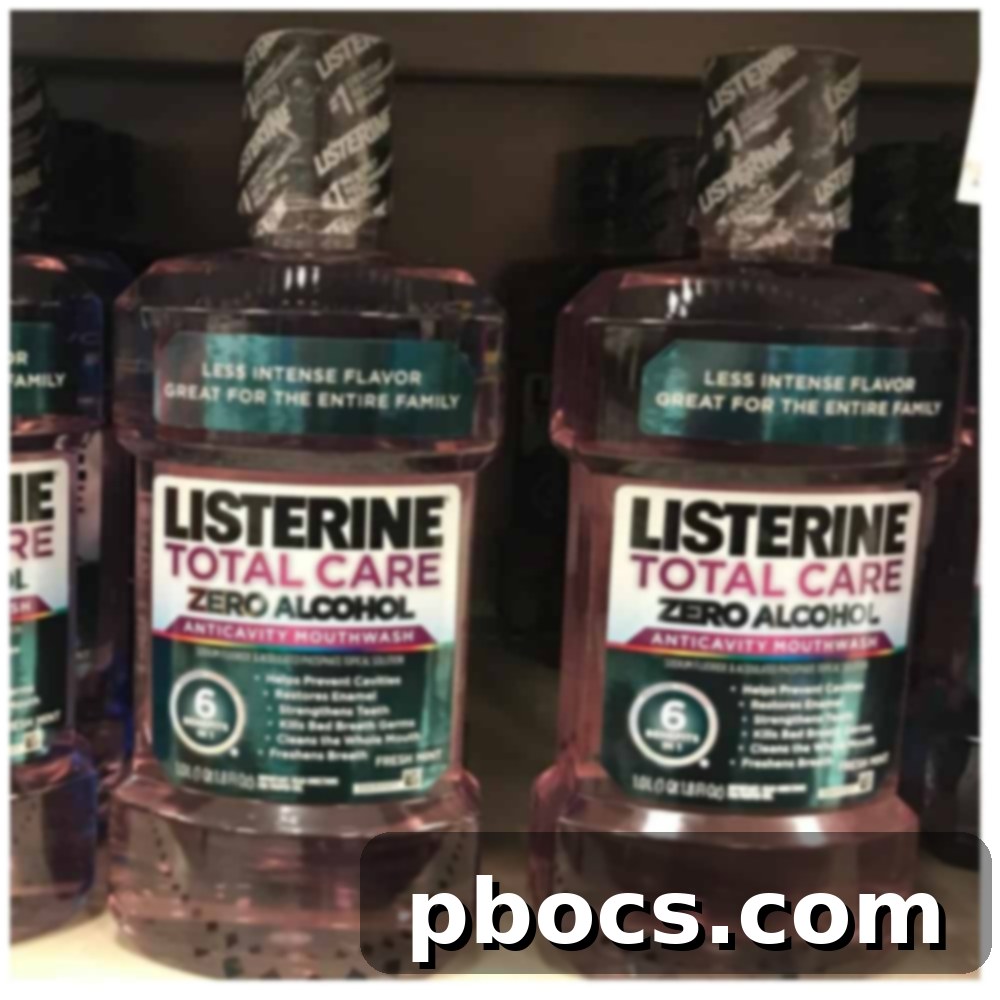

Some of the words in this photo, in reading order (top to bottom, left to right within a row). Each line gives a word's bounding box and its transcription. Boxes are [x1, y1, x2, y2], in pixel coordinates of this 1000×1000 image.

[201, 361, 248, 382] LESS
[252, 364, 338, 384] INTENSE
[342, 368, 423, 386] FLAVOR
[703, 370, 755, 389] LESS
[760, 373, 846, 392] INTENSE
[849, 376, 918, 394] FLAVOR
[163, 381, 222, 402] GREAT
[226, 386, 267, 405] FOR
[273, 388, 312, 408] THE
[317, 391, 390, 410] ENTIRE
[393, 393, 462, 411] FAMILY
[655, 391, 726, 410] GREAT
[731, 394, 776, 414] FOR
[781, 397, 821, 416] THE
[824, 399, 888, 417] ENTIRE
[891, 401, 943, 417] FAMILY
[163, 485, 446, 550] LISTERINE
[630, 496, 912, 559] LISTERINE
[163, 542, 305, 589] TOTAL
[315, 552, 443, 589] CARE
[629, 553, 786, 598] TOTAL
[796, 558, 904, 598] CARE
[186, 585, 270, 619] ZERO
[273, 595, 416, 623] ALCOHOL
[656, 596, 749, 628] ZERO
[751, 602, 881, 629] ALCOHOL
[182, 618, 288, 642] ANTICAVITY
[293, 628, 416, 645] MOUTHWASH
[649, 630, 767, 652] ANTICAVITY
[772, 636, 880, 653] MOUTHWASH
[193, 687, 219, 720] 6
[659, 699, 687, 732] 6
